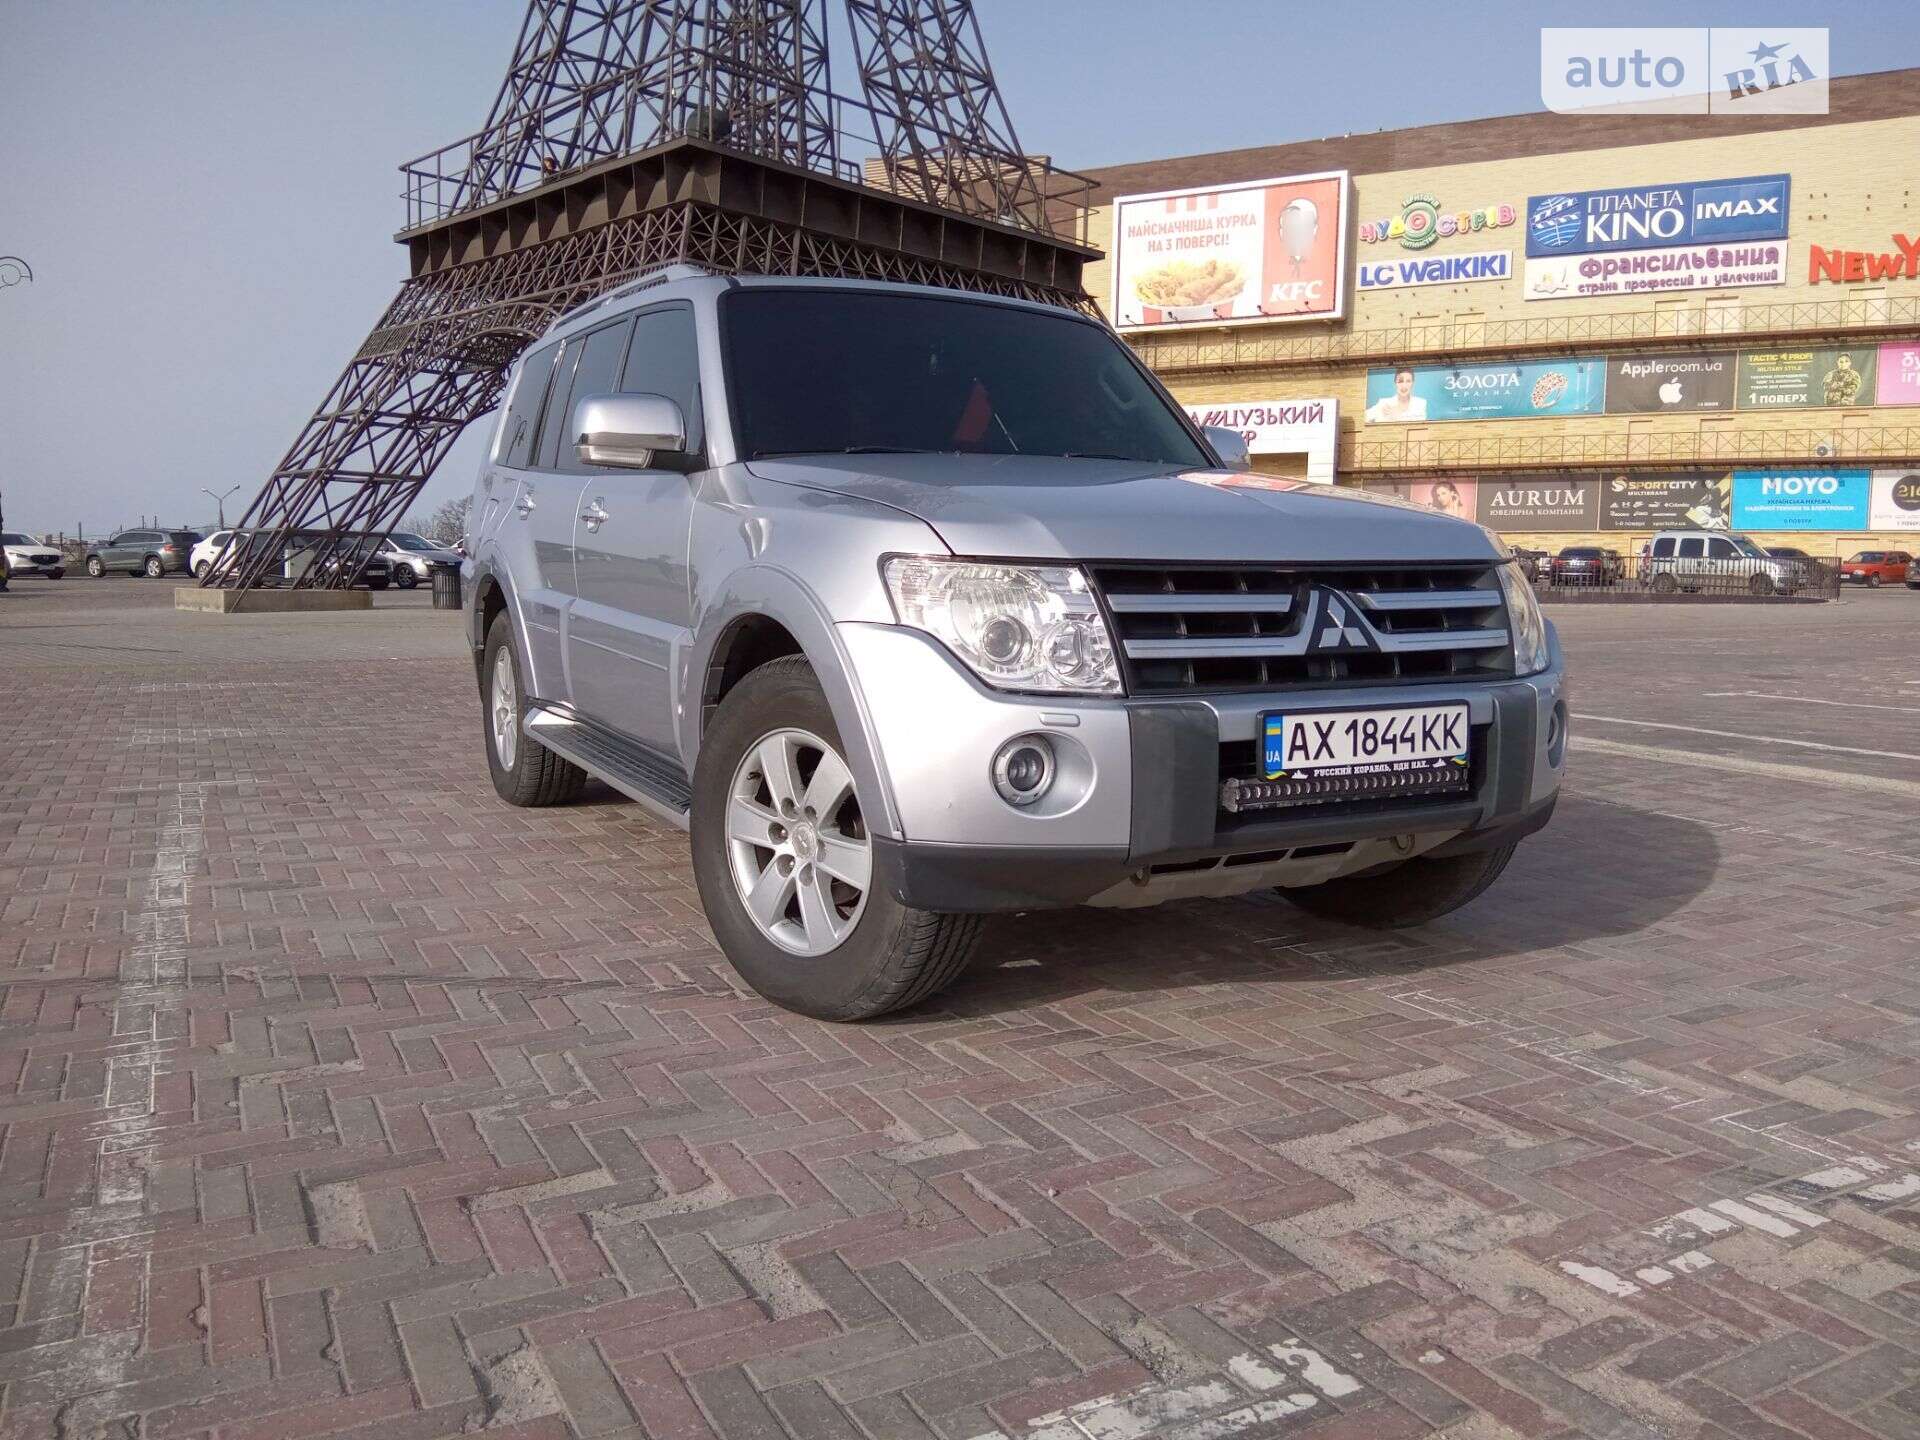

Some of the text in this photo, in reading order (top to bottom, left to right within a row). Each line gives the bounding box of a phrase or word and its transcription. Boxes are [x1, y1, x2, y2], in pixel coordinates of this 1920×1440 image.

[1696, 197, 1779, 220] IMAX
[1128, 214, 1256, 238] НАЙСМАЧНІША КУРКА
[1586, 208, 1684, 243] KINO
[1148, 234, 1230, 252] НА 3 ПОВЕРСІ!
[1360, 265, 1394, 286] LC
[1578, 269, 1778, 295] страна профессий и увлечений
[1269, 280, 1324, 301] KFC
[1620, 360, 1722, 378] Appleroom.ua
[1444, 373, 1520, 390] ЗОЛОТА
[1749, 393, 1807, 404] 1 ПОВЕРХ
[1629, 480, 1697, 490] SPORTCITY
[1762, 477, 1838, 495] MOYO
[1490, 490, 1585, 506] AURUM
[1287, 720, 1337, 762] AX
[1266, 751, 1281, 764] UA
[1314, 766, 1352, 777] РУССКИЙ
